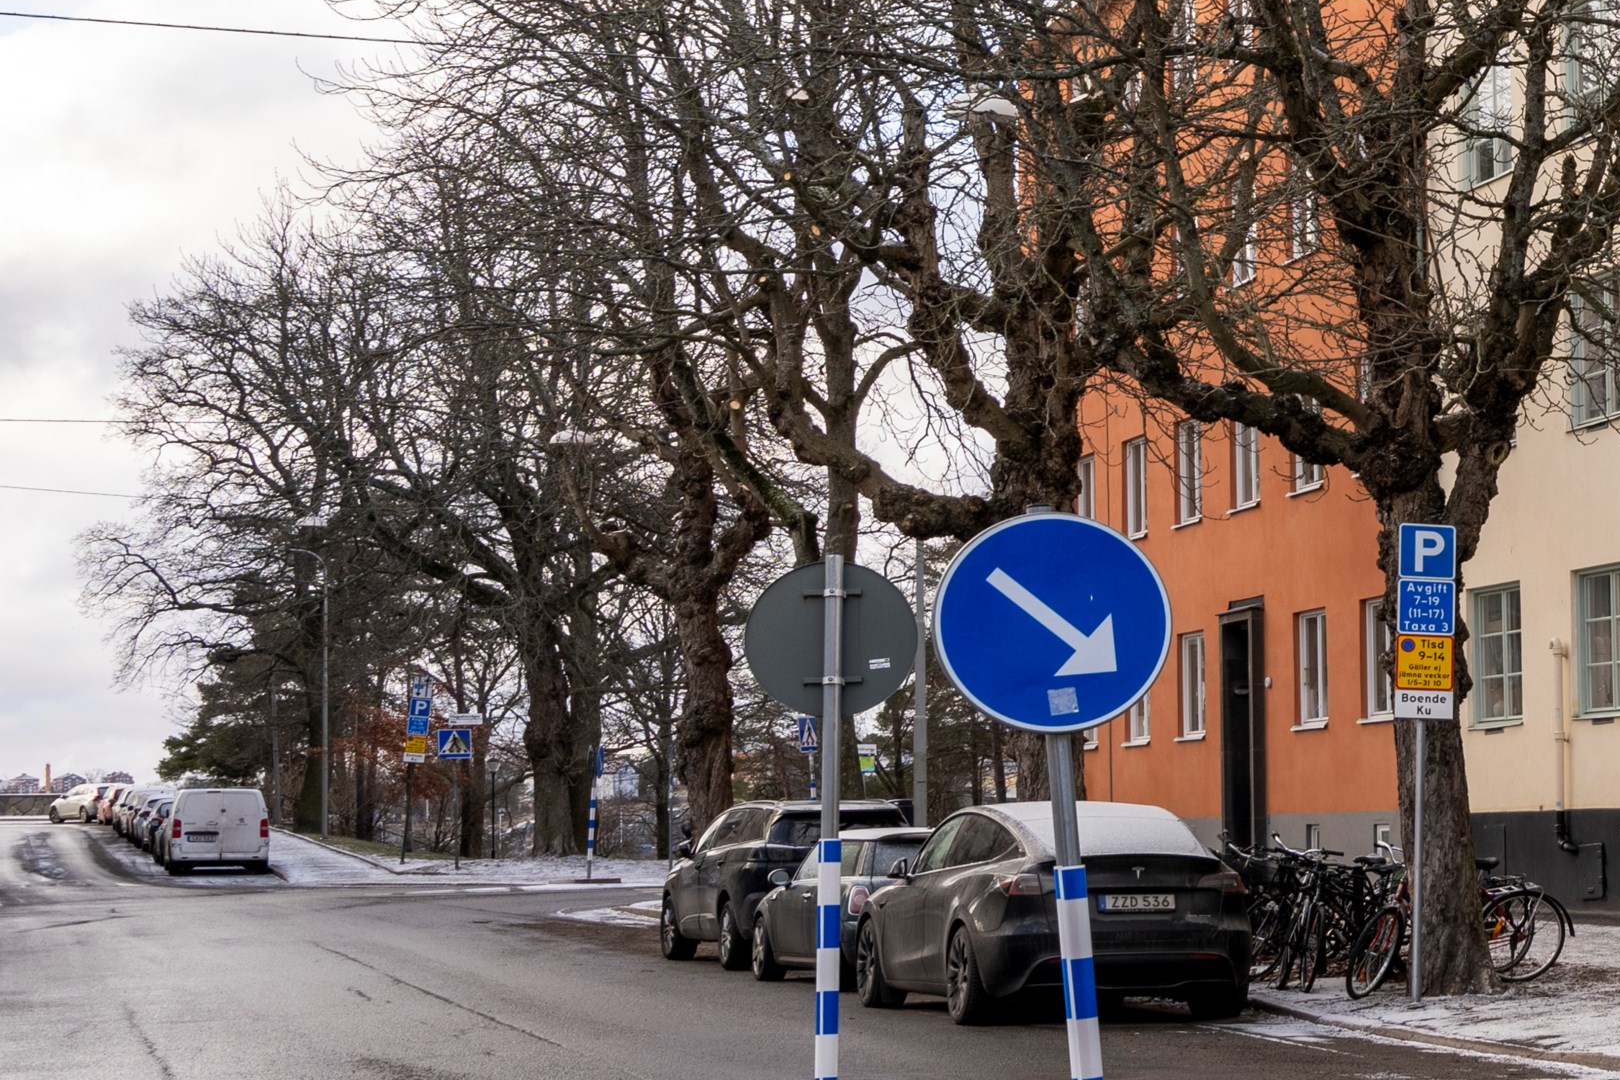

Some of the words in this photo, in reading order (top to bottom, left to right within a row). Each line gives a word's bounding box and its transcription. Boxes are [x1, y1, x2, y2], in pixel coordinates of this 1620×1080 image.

[1414, 530, 1445, 572] P
[1407, 582, 1447, 595] Avgift
[1413, 595, 1440, 606] 7-19
[1408, 607, 1445, 620] (11-17)
[1404, 620, 1435, 632] Taxa
[1441, 622, 1449, 632] 3
[1421, 639, 1444, 649] Tisd
[1418, 651, 1445, 661] 9-14
[1408, 663, 1431, 671] Gäller
[1399, 671, 1422, 679] jämna
[1424, 672, 1450, 680] veckor
[1401, 693, 1447, 704] Boende
[414, 700, 427, 714] P
[1416, 705, 1432, 716] Ku
[1111, 896, 1138, 908] ZZD
[1143, 896, 1170, 908] 536
